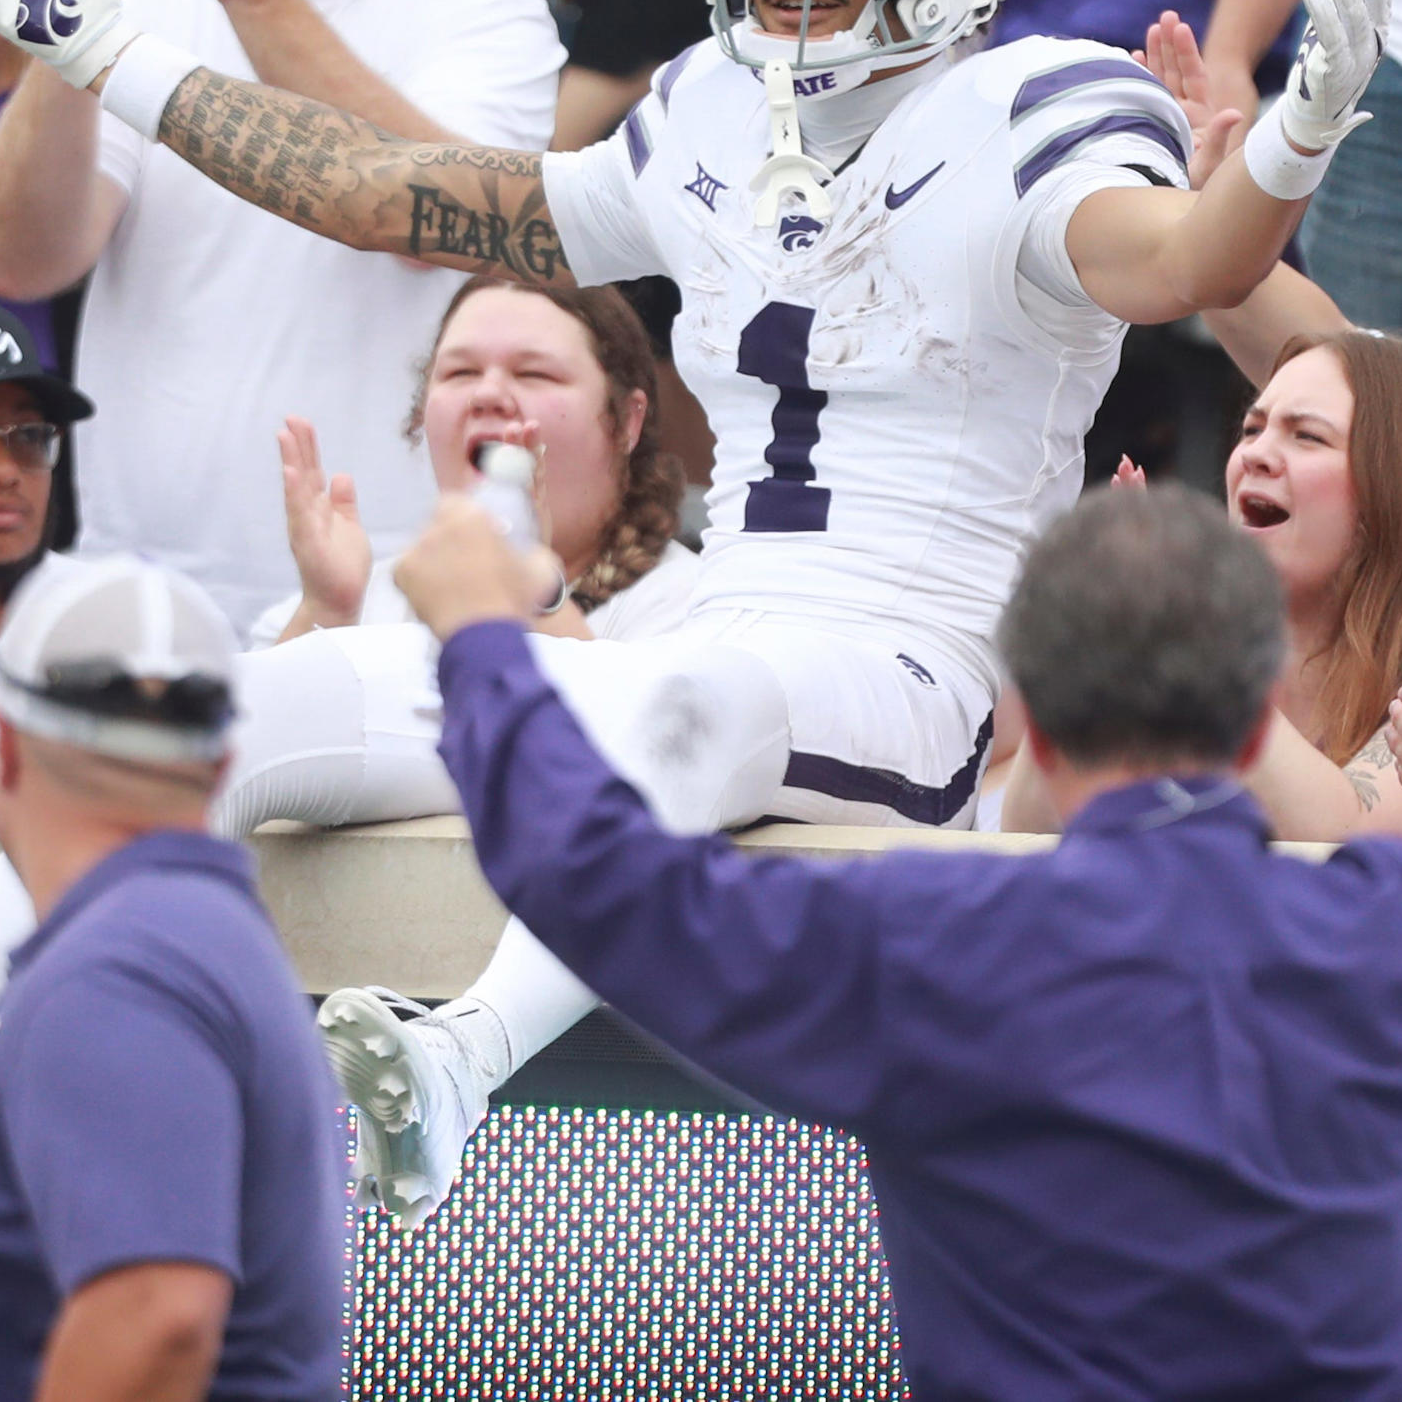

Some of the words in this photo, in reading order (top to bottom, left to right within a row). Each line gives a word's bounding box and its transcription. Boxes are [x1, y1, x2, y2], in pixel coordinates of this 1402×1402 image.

[792, 72, 837, 97] ATE
[406, 183, 516, 269] FEAR
[519, 218, 572, 281] G
[735, 300, 832, 533] 1
